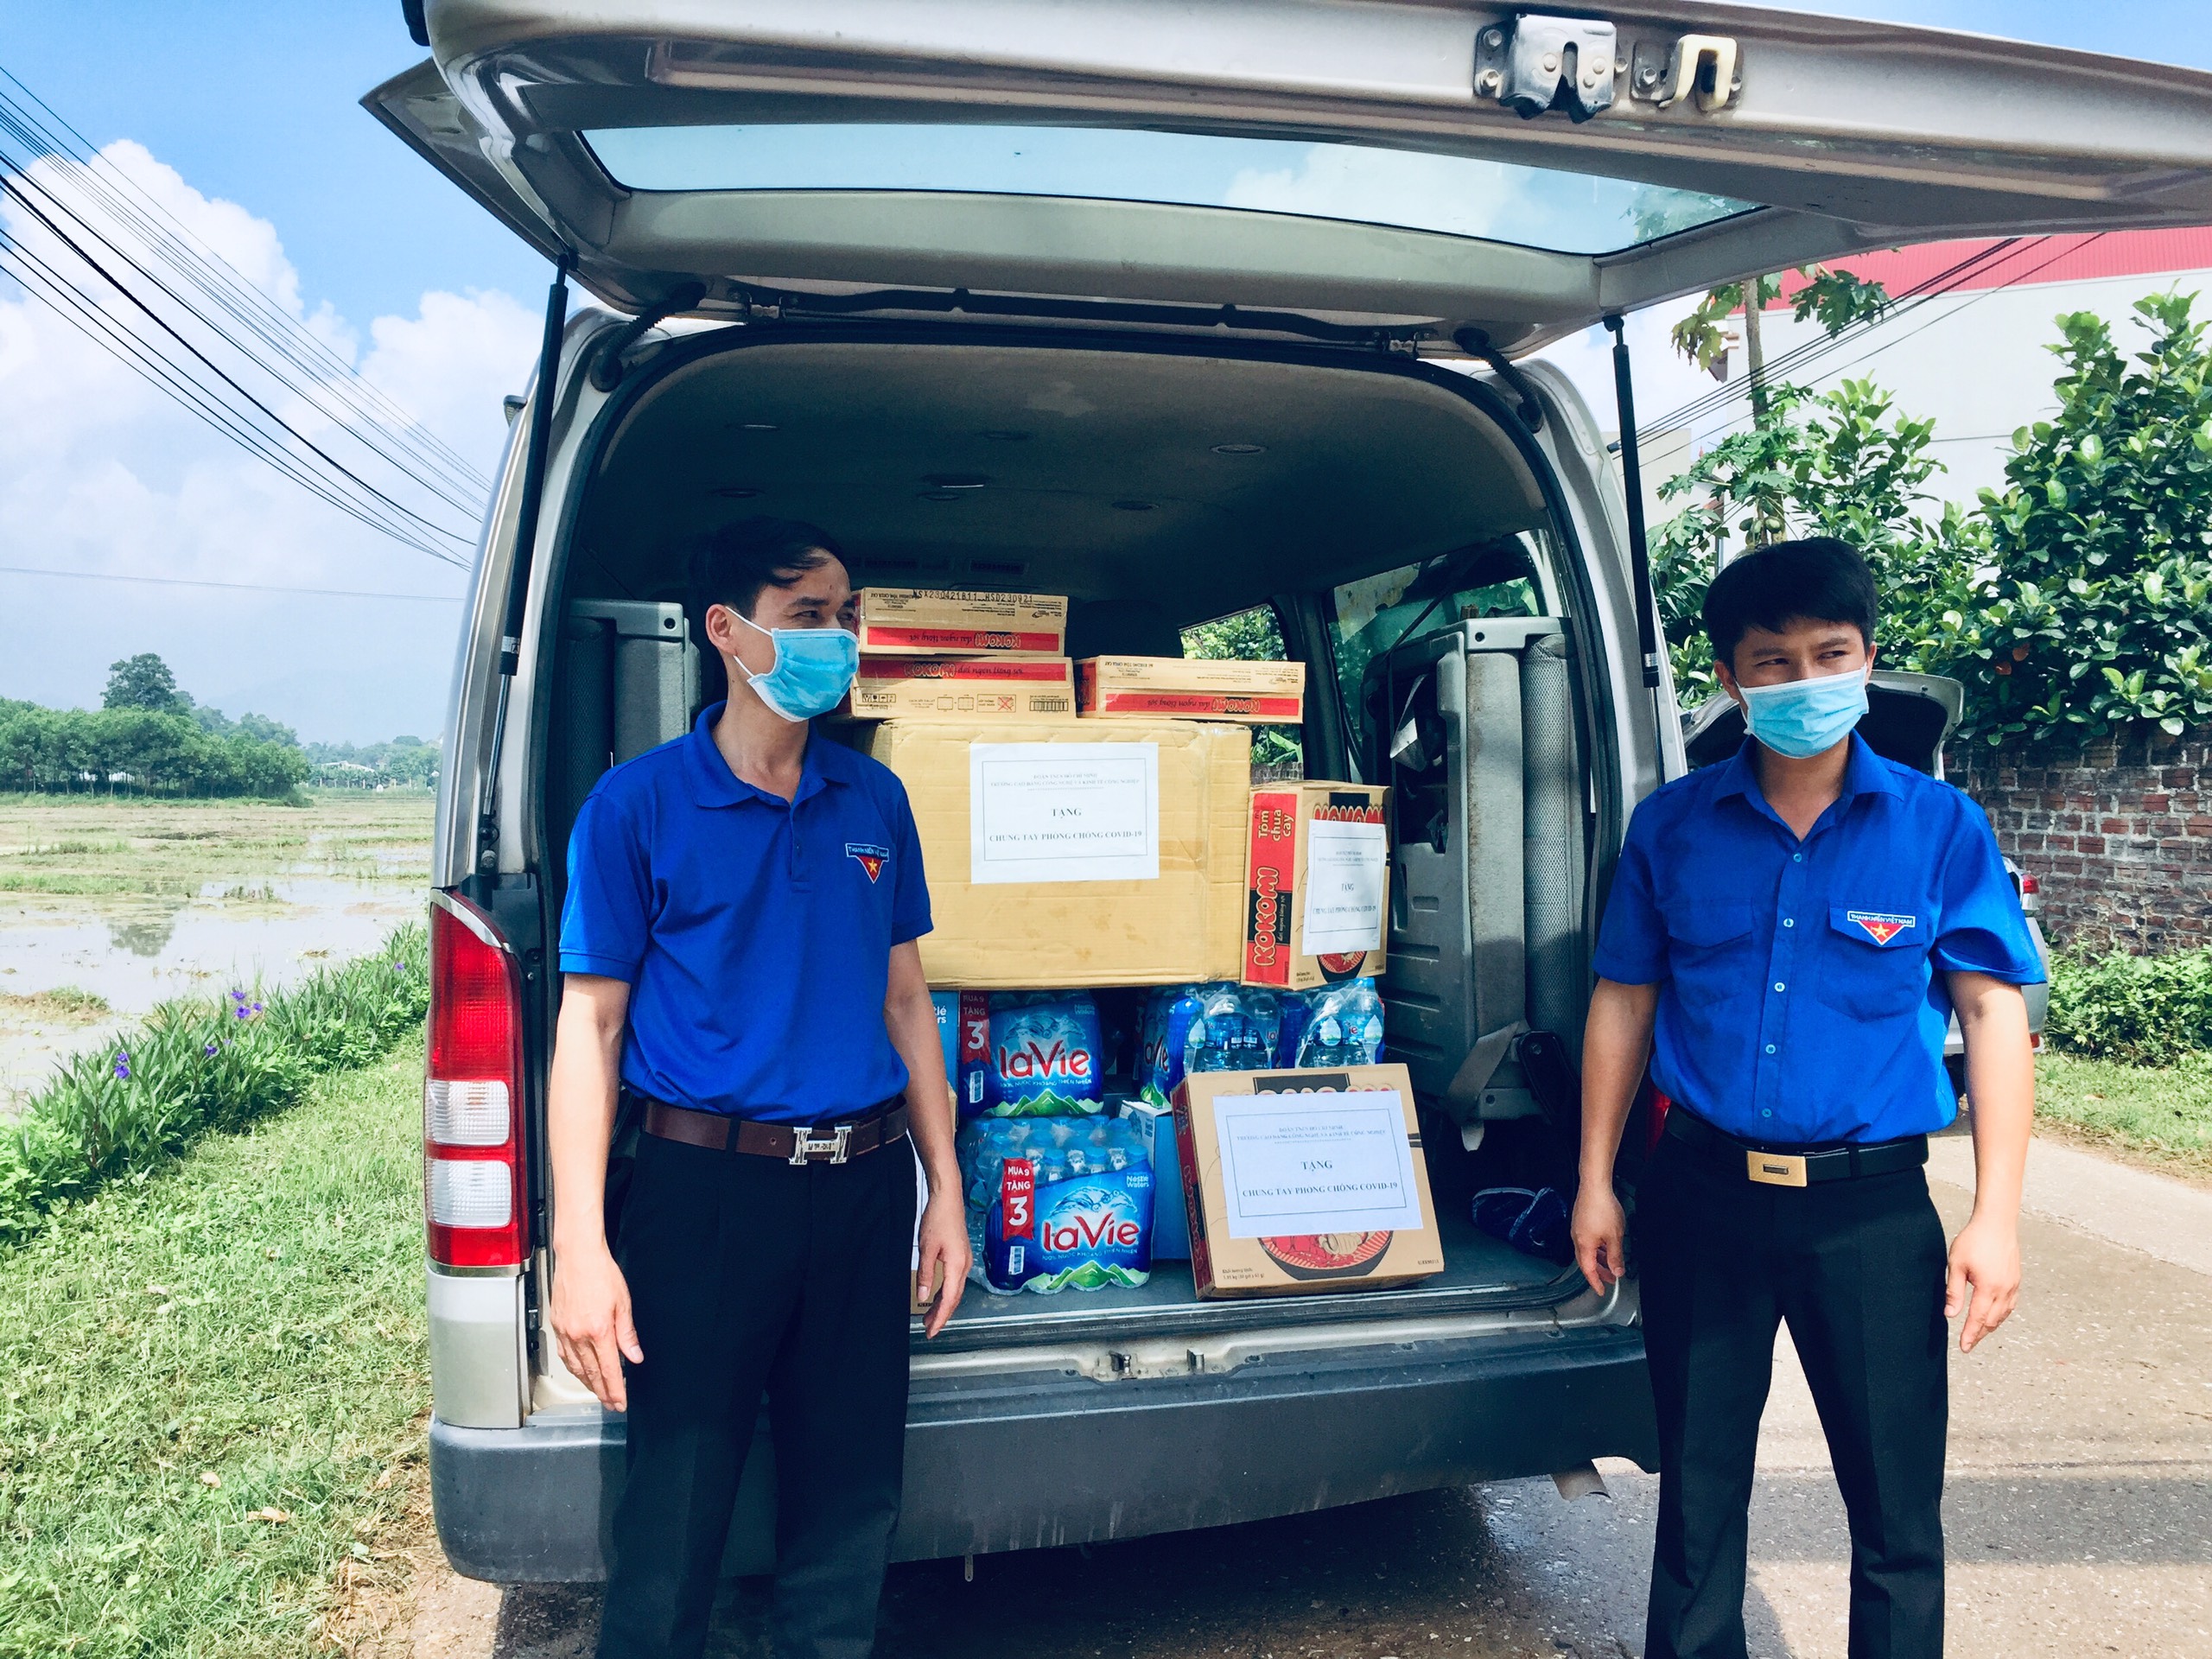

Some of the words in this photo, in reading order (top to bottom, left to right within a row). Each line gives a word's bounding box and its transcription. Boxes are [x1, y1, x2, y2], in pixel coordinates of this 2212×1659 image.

[975, 632, 1021, 648] KOKOMI
[904, 663, 956, 677] KOKOMI
[1211, 697, 1261, 713] KOKOMI
[1270, 809, 1282, 842] chua
[1282, 813, 1294, 838] cay
[1253, 866, 1279, 966] KOKOMI
[967, 1020, 985, 1050] 3
[999, 1039, 1090, 1079] laVie
[1007, 1166, 1025, 1175] MUA
[1024, 1168, 1030, 1177] 9
[1243, 1188, 1274, 1198] CHUNG
[1274, 1186, 1293, 1196] TAY
[1360, 1182, 1398, 1192] COVID-19
[1008, 1196, 1028, 1226] 3
[1042, 1211, 1140, 1252] laVie
